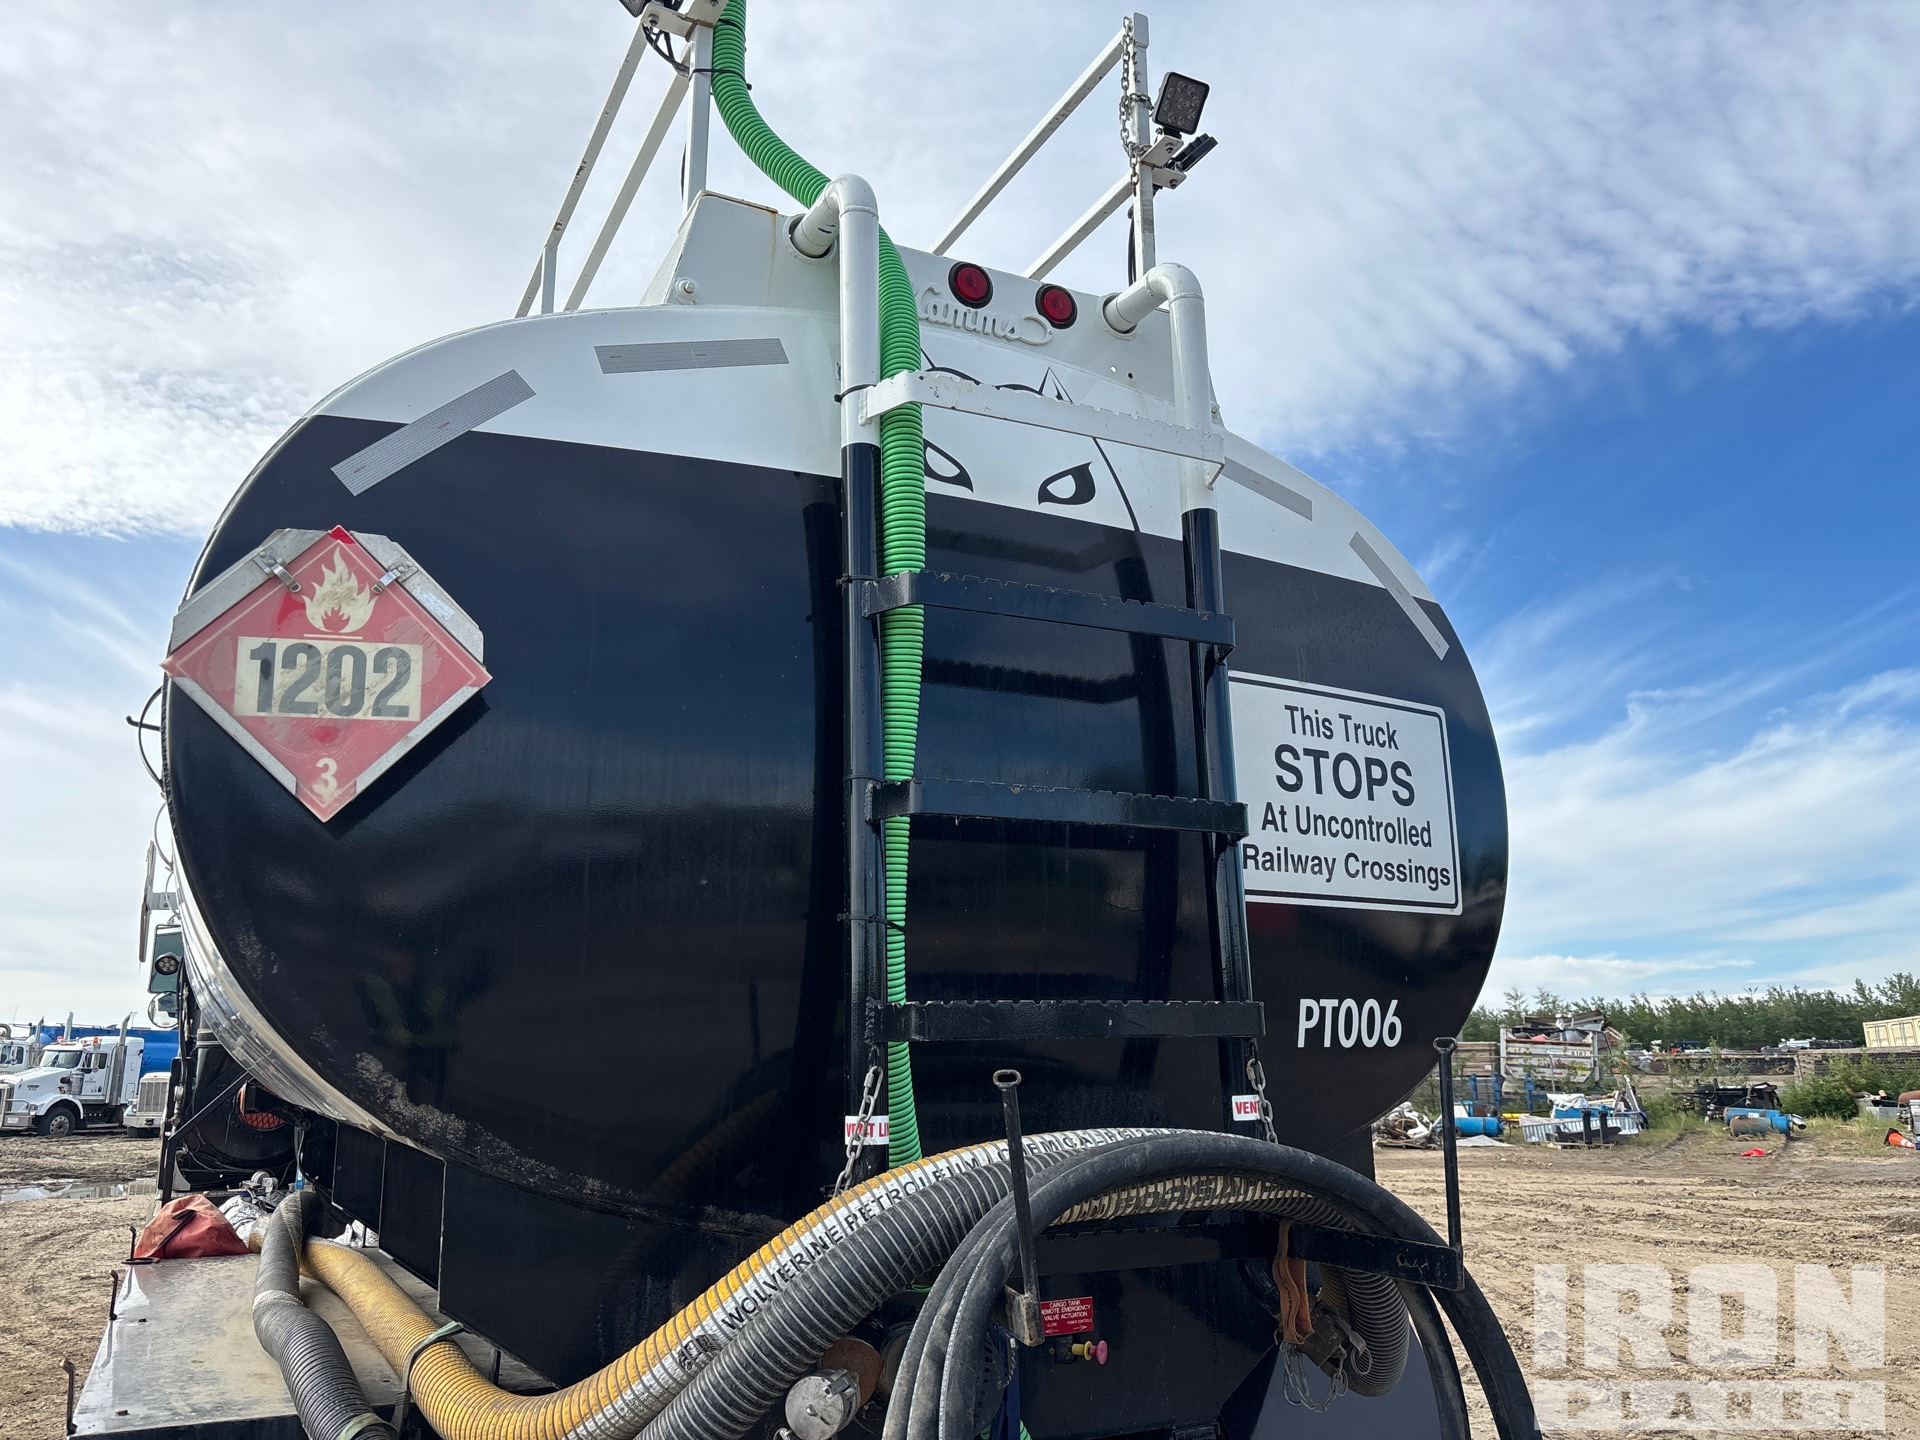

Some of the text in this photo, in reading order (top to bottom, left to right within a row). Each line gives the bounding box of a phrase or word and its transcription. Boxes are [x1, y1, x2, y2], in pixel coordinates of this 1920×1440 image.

[250, 641, 412, 718] 1202
[1284, 704, 1399, 750] This Truck
[312, 757, 338, 796] 3
[1274, 743, 1415, 806] STOPS
[1261, 802, 1433, 848] At Uncontrolled
[1242, 843, 1451, 892] Railway Crossings
[1297, 998, 1403, 1048] PT006
[721, 1225, 844, 1331] WOLVERINE
[1049, 1301, 1067, 1309] CARGO
[1061, 1304, 1091, 1313] EMERGENCY
[1061, 1311, 1088, 1319] ACTUATION
